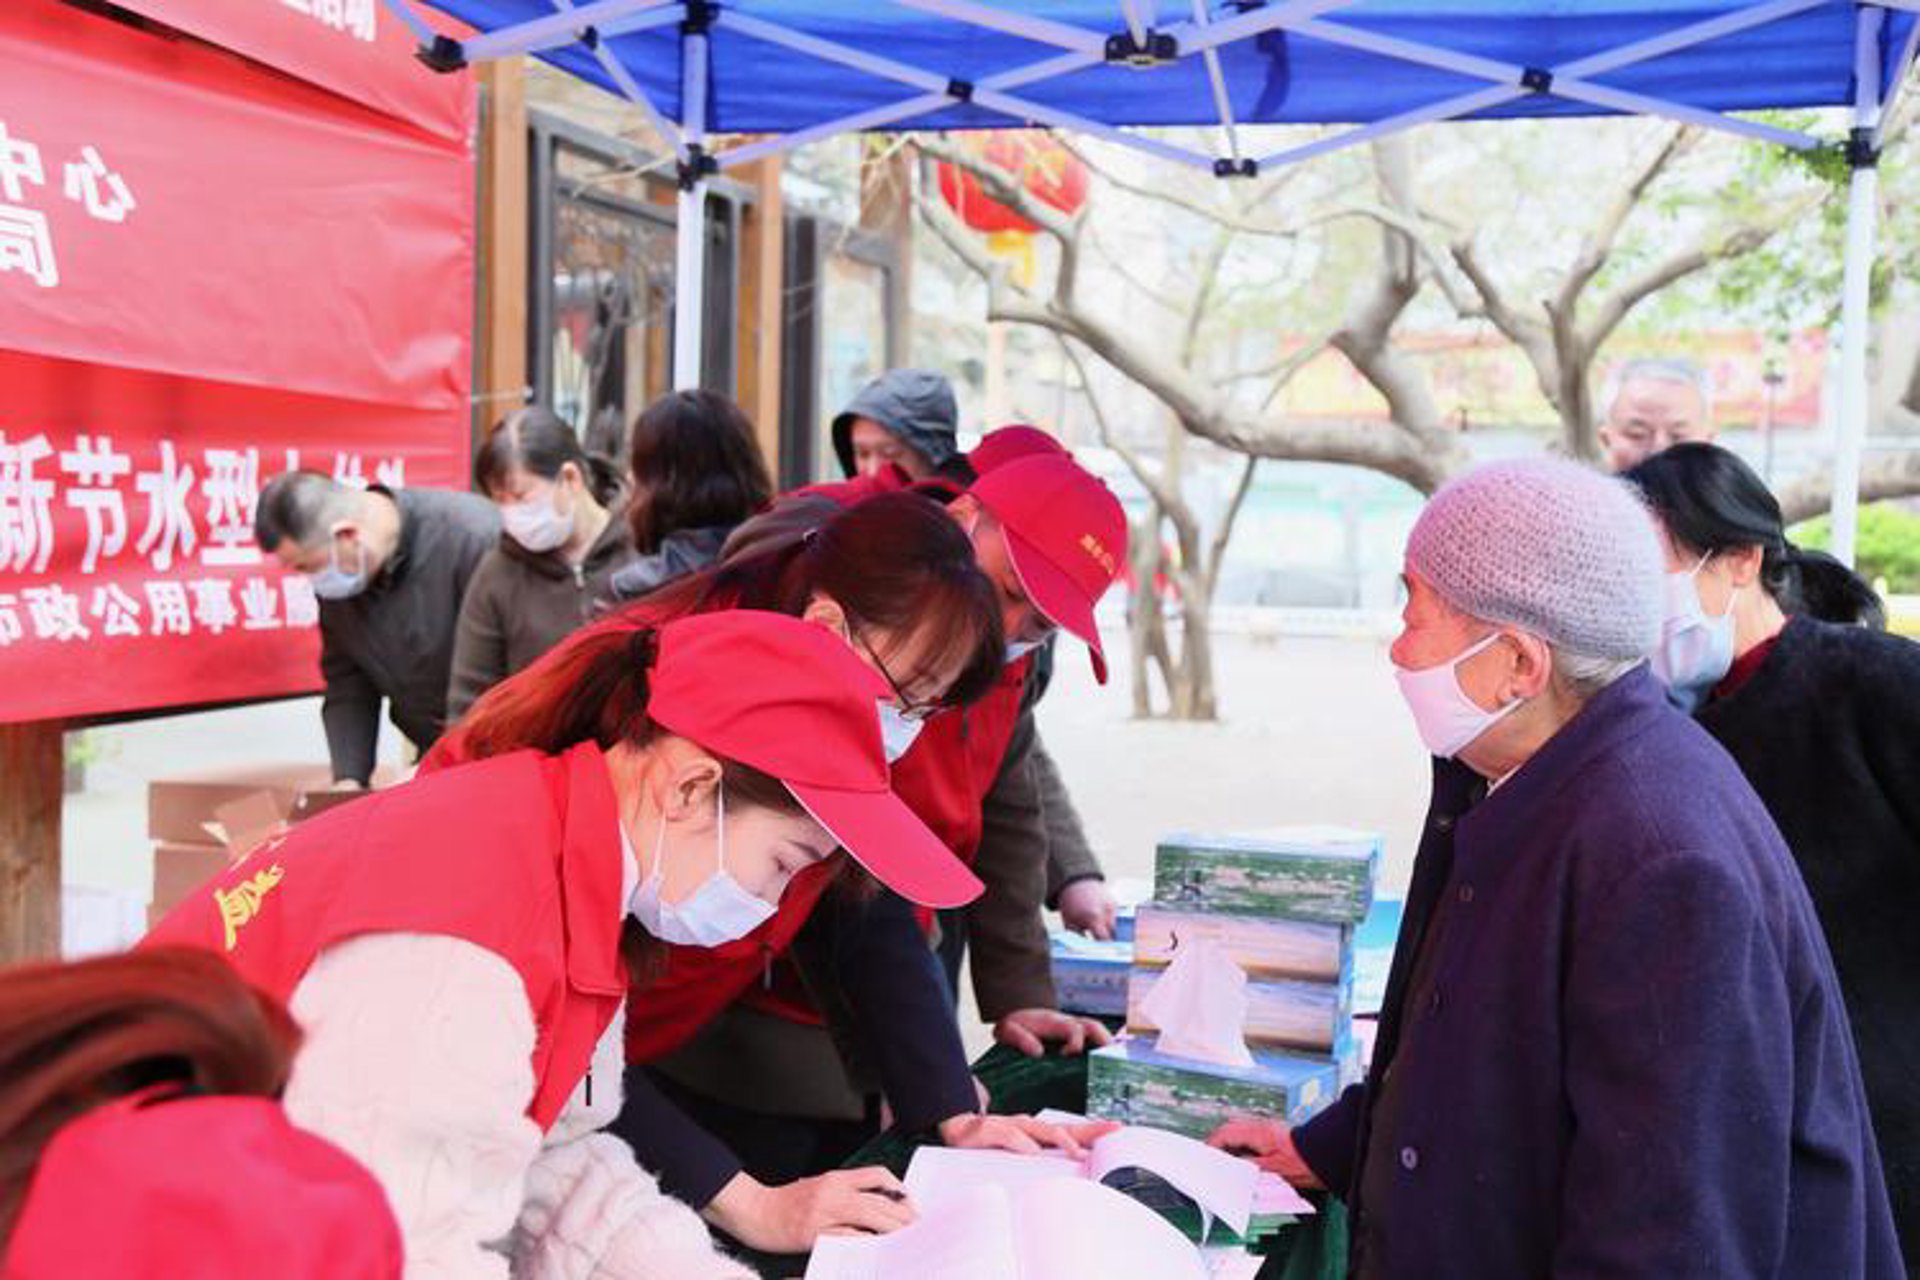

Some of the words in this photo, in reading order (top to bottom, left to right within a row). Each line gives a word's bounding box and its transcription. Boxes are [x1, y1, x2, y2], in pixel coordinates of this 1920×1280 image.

[0, 121, 137, 223] 中心
[0, 429, 405, 575] 新节水型
